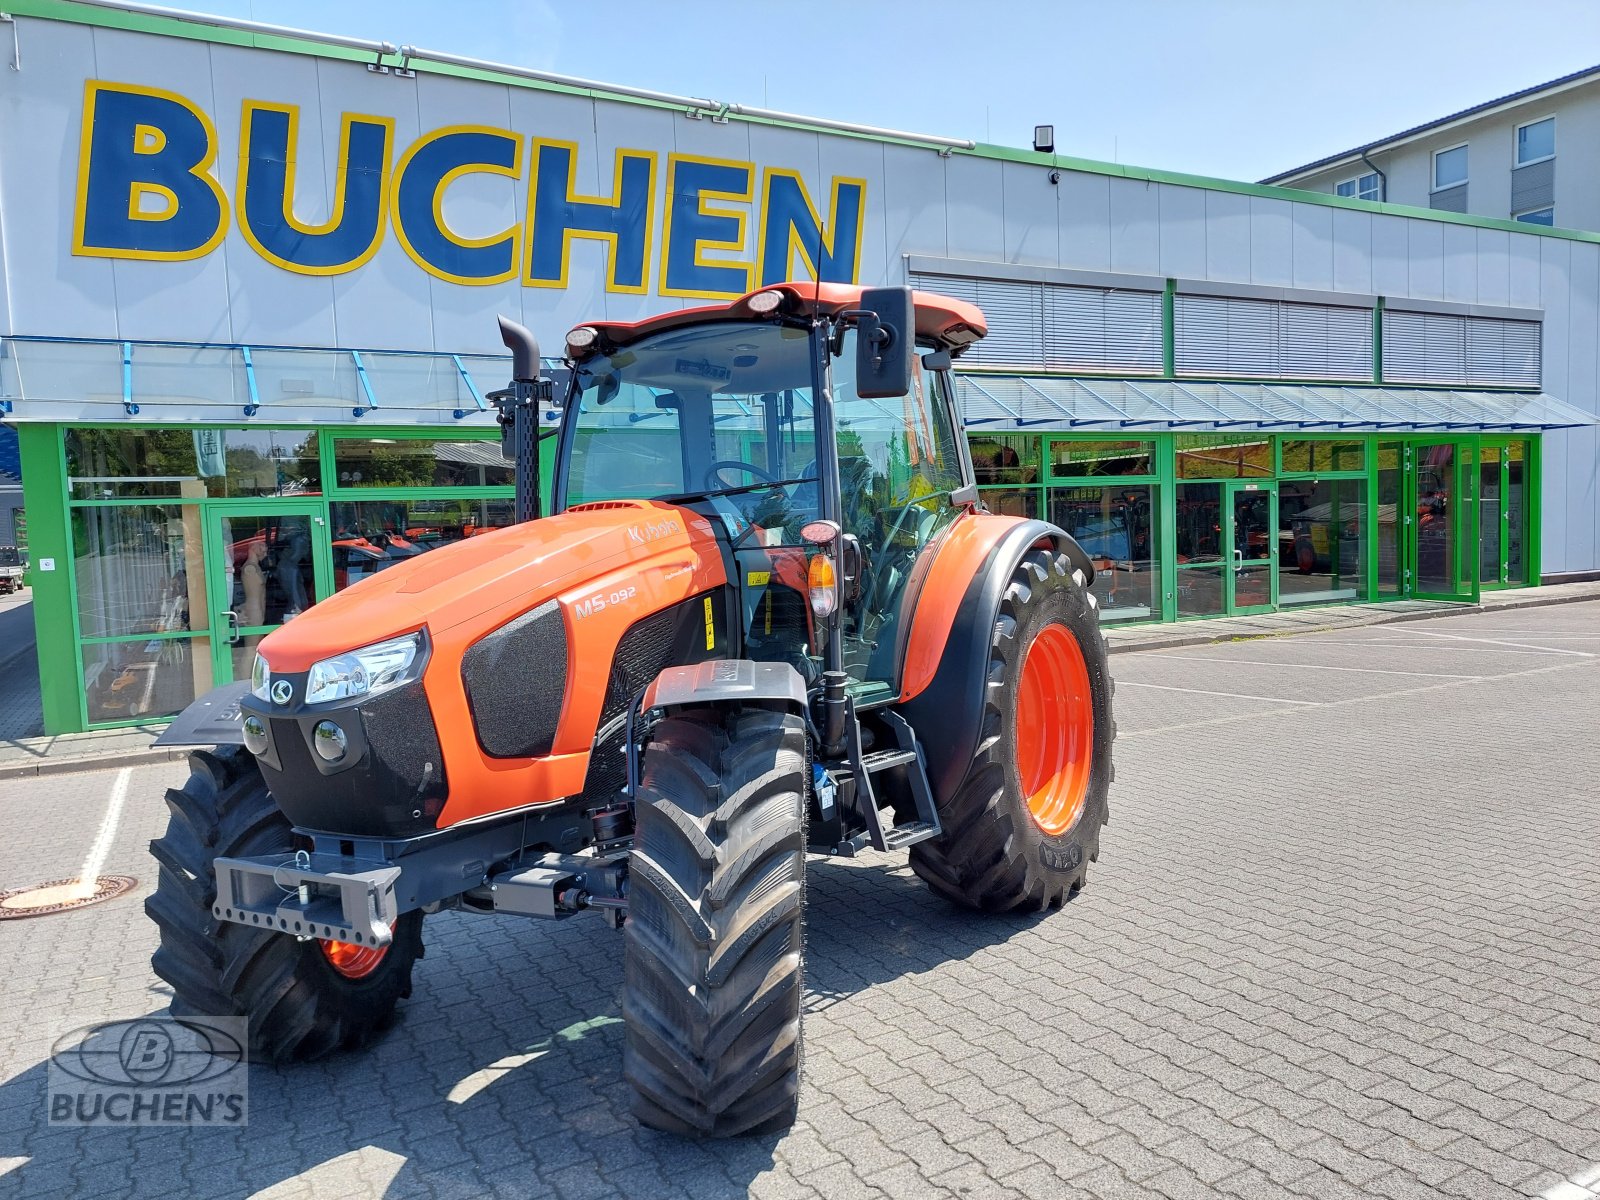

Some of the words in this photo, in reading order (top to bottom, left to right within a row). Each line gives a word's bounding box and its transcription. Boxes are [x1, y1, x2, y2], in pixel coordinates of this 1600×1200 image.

[72, 79, 867, 300] BUCHEN
[627, 517, 680, 544] Kubota
[575, 586, 636, 621] M5-092
